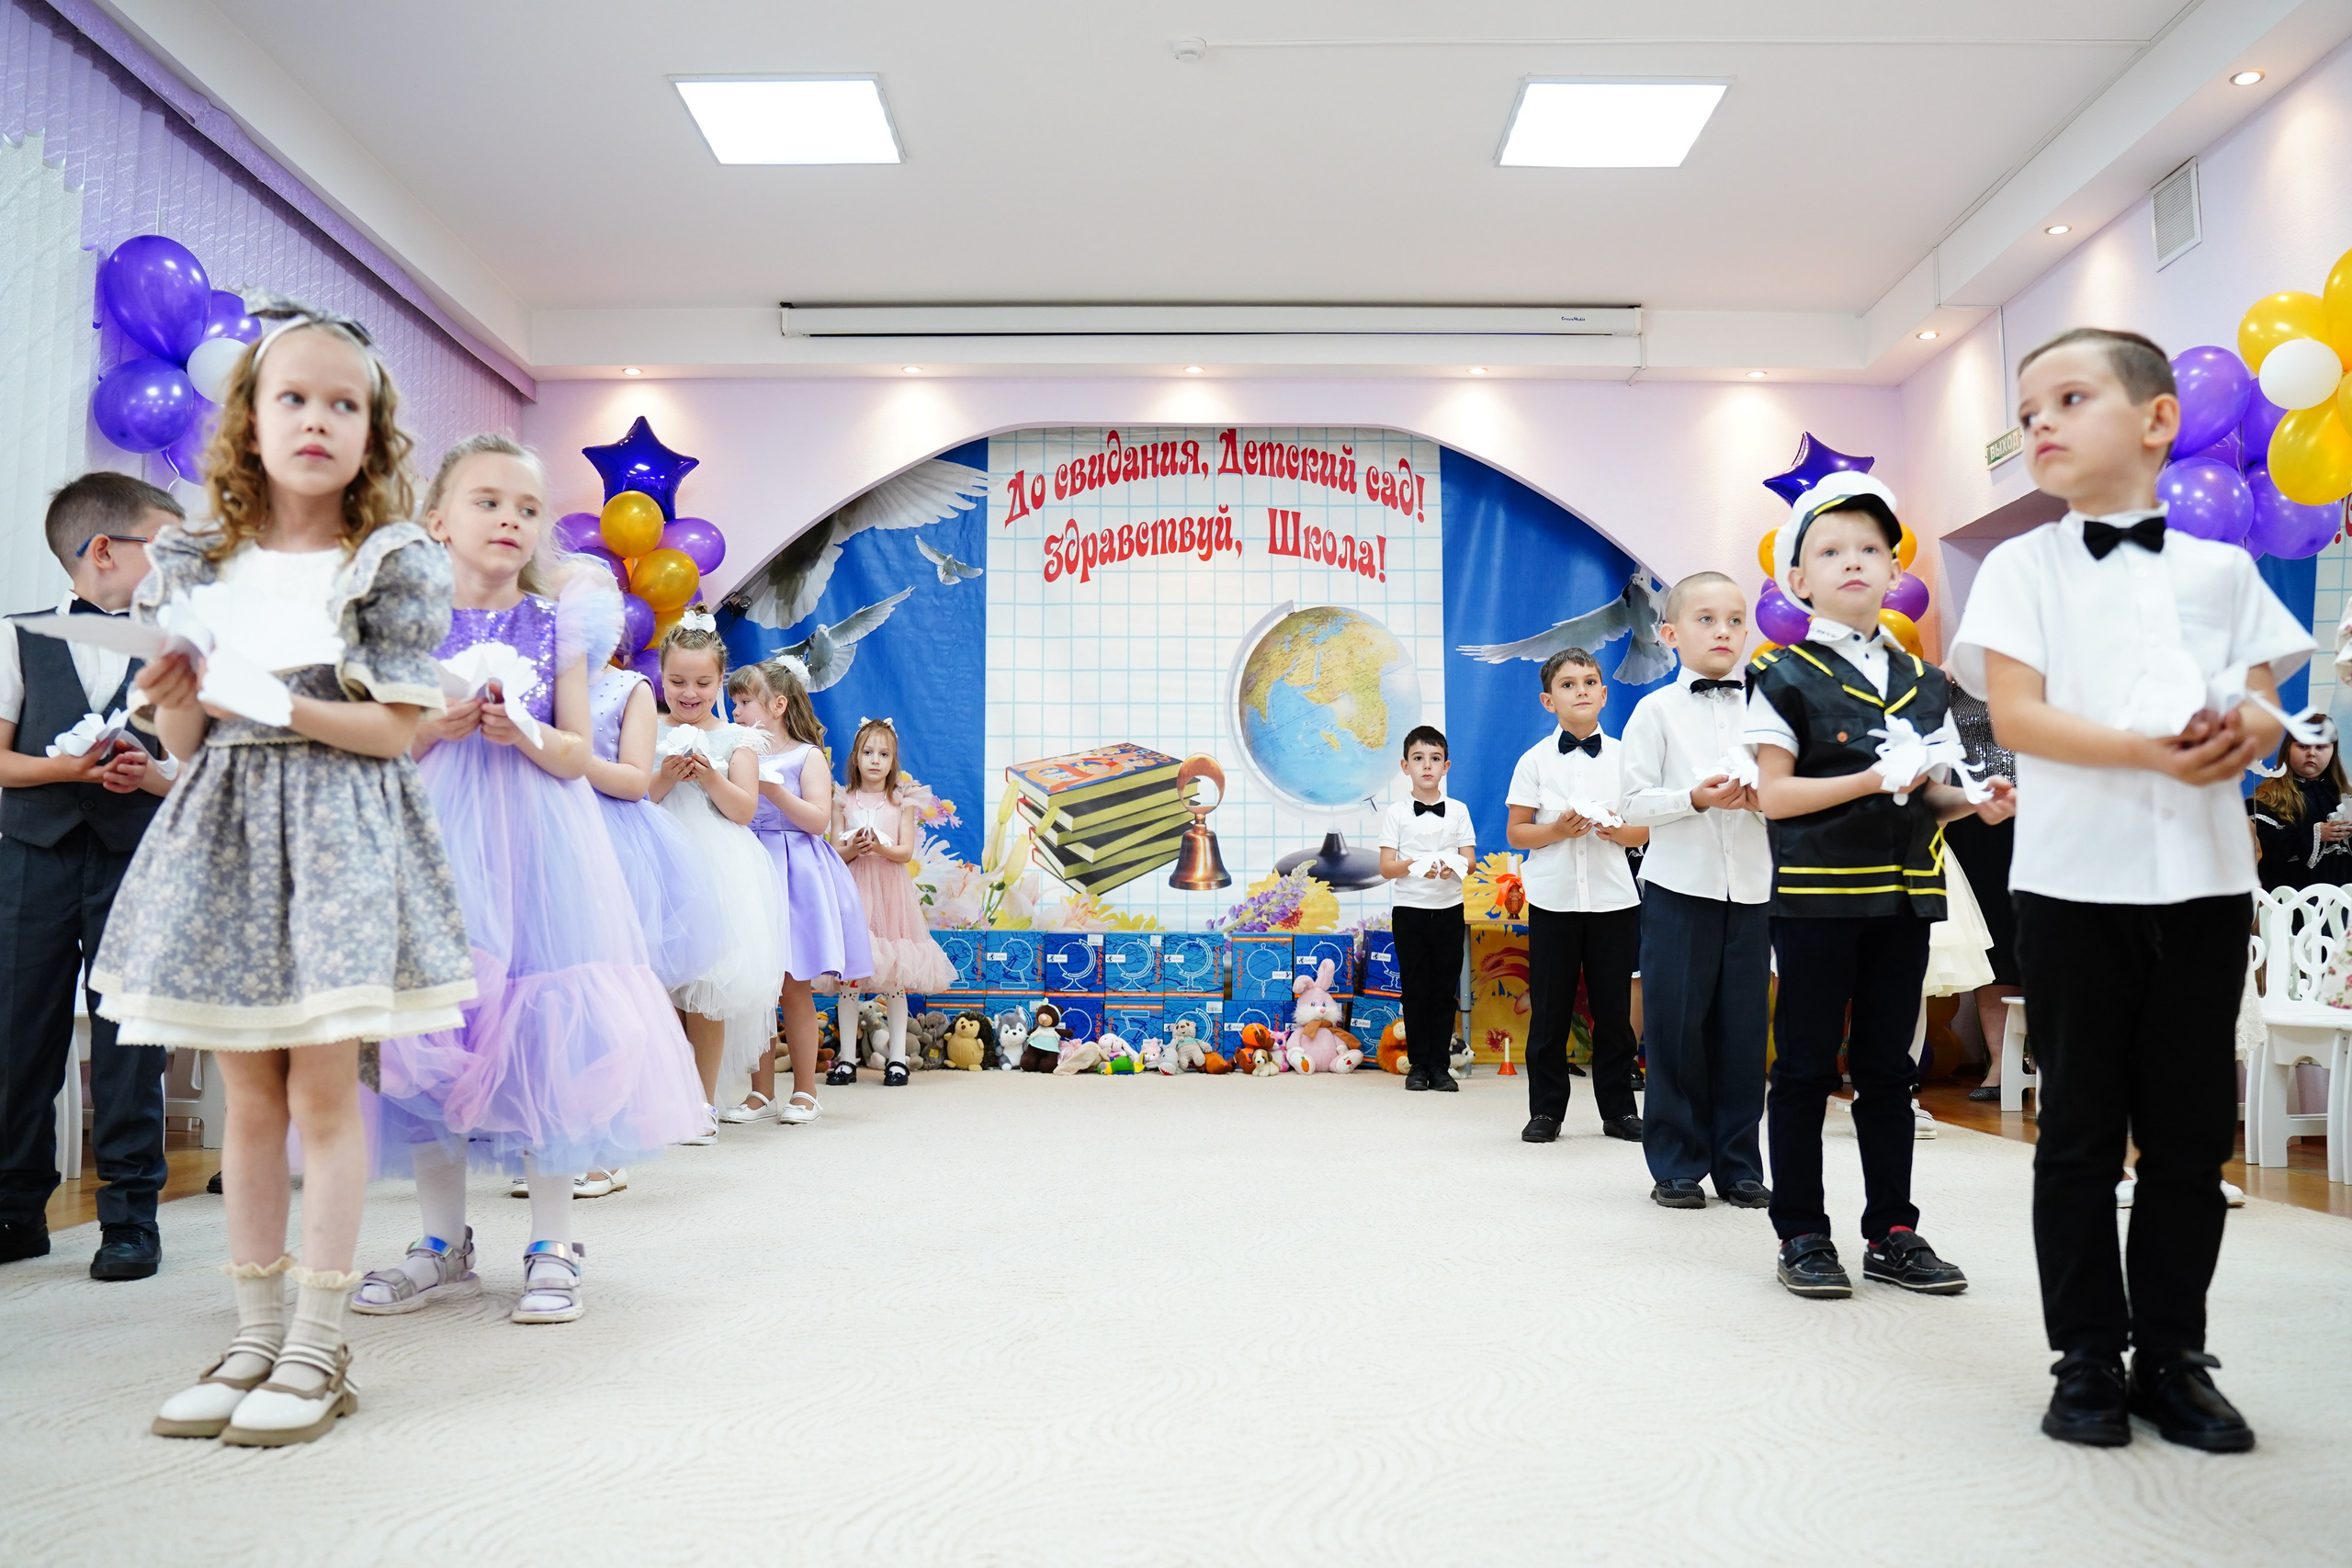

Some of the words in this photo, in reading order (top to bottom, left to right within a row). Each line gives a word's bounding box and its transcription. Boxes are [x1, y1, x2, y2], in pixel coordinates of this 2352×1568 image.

[1005, 470, 1046, 527] До
[1055, 430, 1210, 501] свидания,
[1217, 429, 1358, 495] Детский
[1366, 458, 1425, 523] сад!
[1990, 432, 2019, 460] ВЫХОД
[1268, 508, 1386, 583] Школа!
